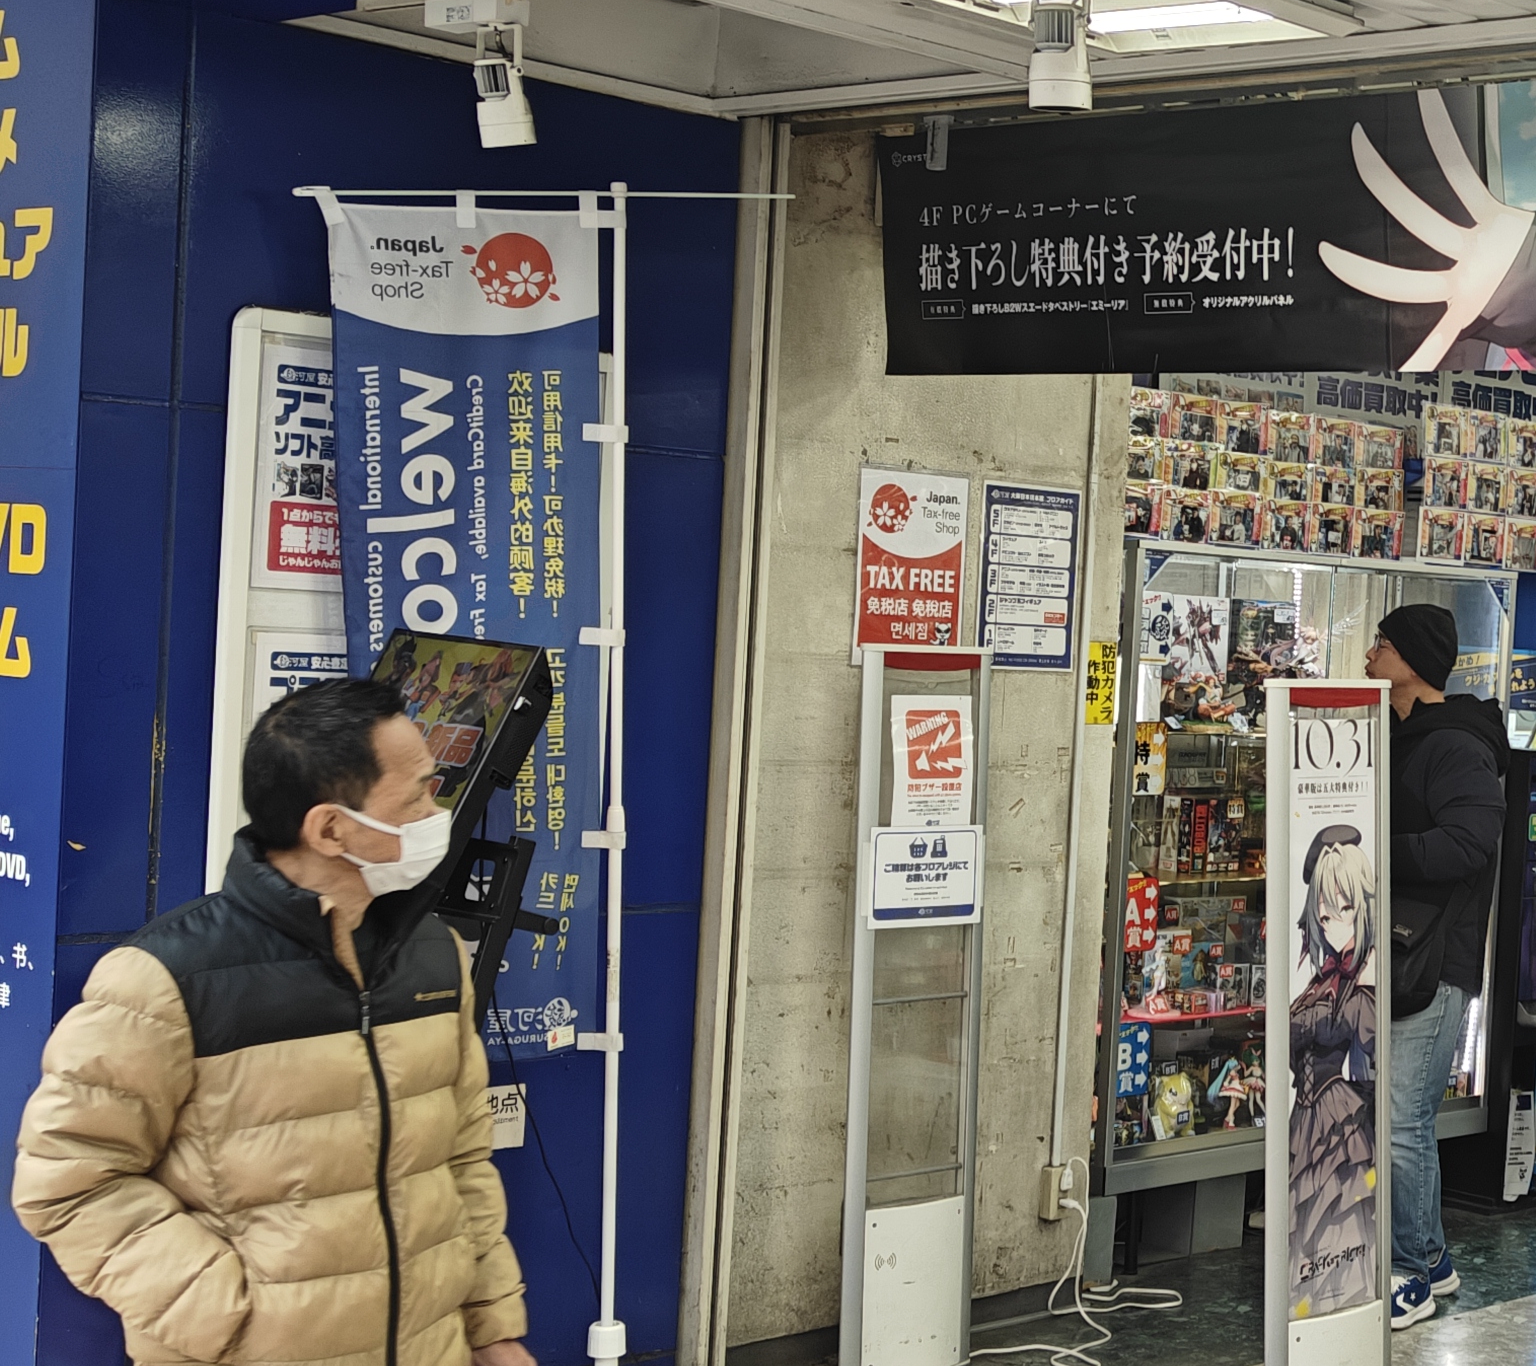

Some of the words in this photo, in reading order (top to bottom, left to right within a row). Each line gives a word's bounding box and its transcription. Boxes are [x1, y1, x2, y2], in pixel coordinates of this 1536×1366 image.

[919, 205, 944, 227] 4F
[951, 195, 1137, 226] PCゲームコーナーにて
[921, 506, 961, 521] Tax-free
[934, 521, 960, 537] Shop
[279, 524, 342, 556] 無料
[866, 564, 905, 591] TAX
[909, 567, 956, 594] FREE
[890, 621, 929, 641] 면세점
[1085, 659, 1100, 706] 作動中
[1101, 643, 1116, 723] 防犯カメラ
[906, 711, 949, 741] WARNING
[1293, 718, 1373, 777] 10.31
[1125, 897, 1143, 951] A賞
[1117, 1043, 1135, 1094] B賞
